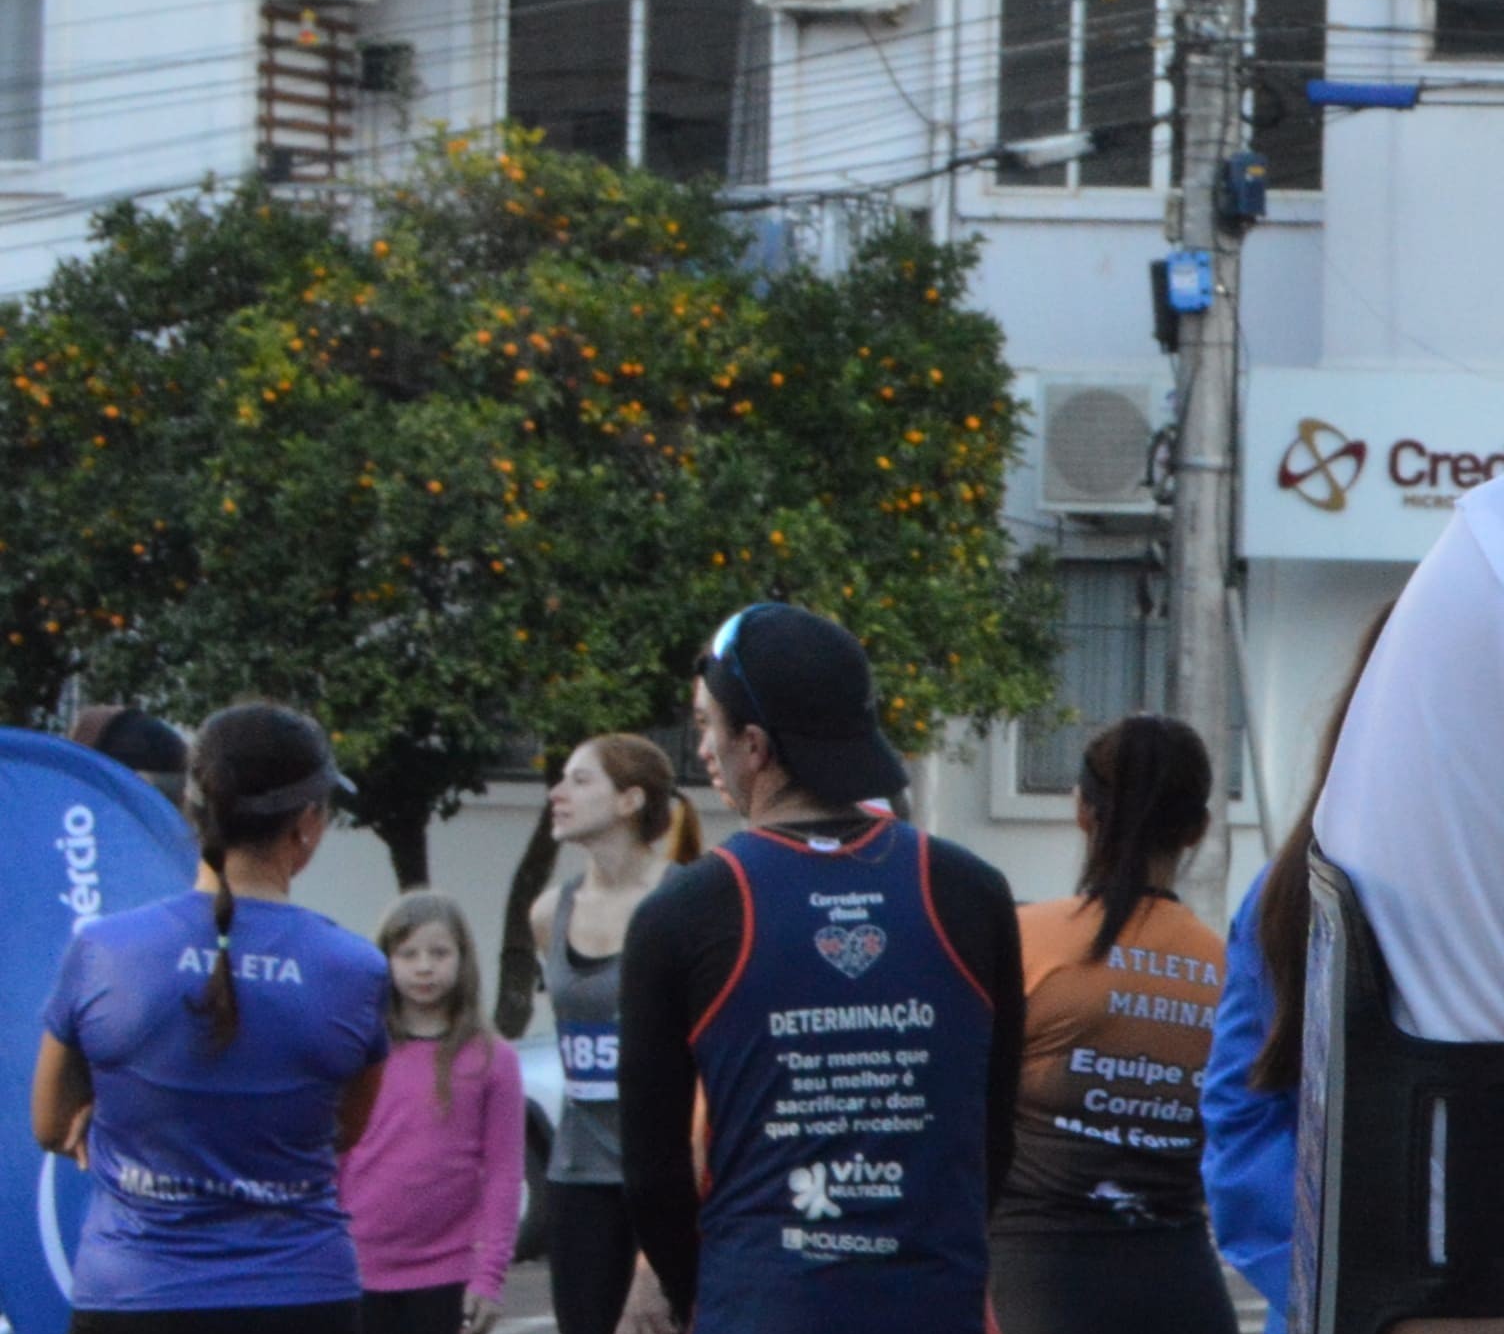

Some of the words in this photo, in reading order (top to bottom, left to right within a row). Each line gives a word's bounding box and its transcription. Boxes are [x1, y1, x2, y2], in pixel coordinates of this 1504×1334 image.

[177, 946, 303, 985] ATETA
[1107, 944, 1219, 987] ATLETA
[768, 998, 936, 1037] DETERMINAÇÃO
[1108, 989, 1217, 1030] MARINA
[560, 1033, 620, 1071] 185
[827, 1049, 891, 1068] menos
[895, 1047, 930, 1068] que
[1069, 1046, 1184, 1086] Equipe
[792, 1077, 828, 1093] seu
[831, 1070, 899, 1090] melhor
[902, 1069, 915, 1088] é
[775, 1095, 867, 1116] sacrificar
[869, 1096, 883, 1110] o
[886, 1091, 926, 1110] dom
[1083, 1087, 1195, 1124] Corrida
[764, 1120, 800, 1141] que
[805, 1115, 849, 1136] você
[830, 1151, 904, 1183] vivo
